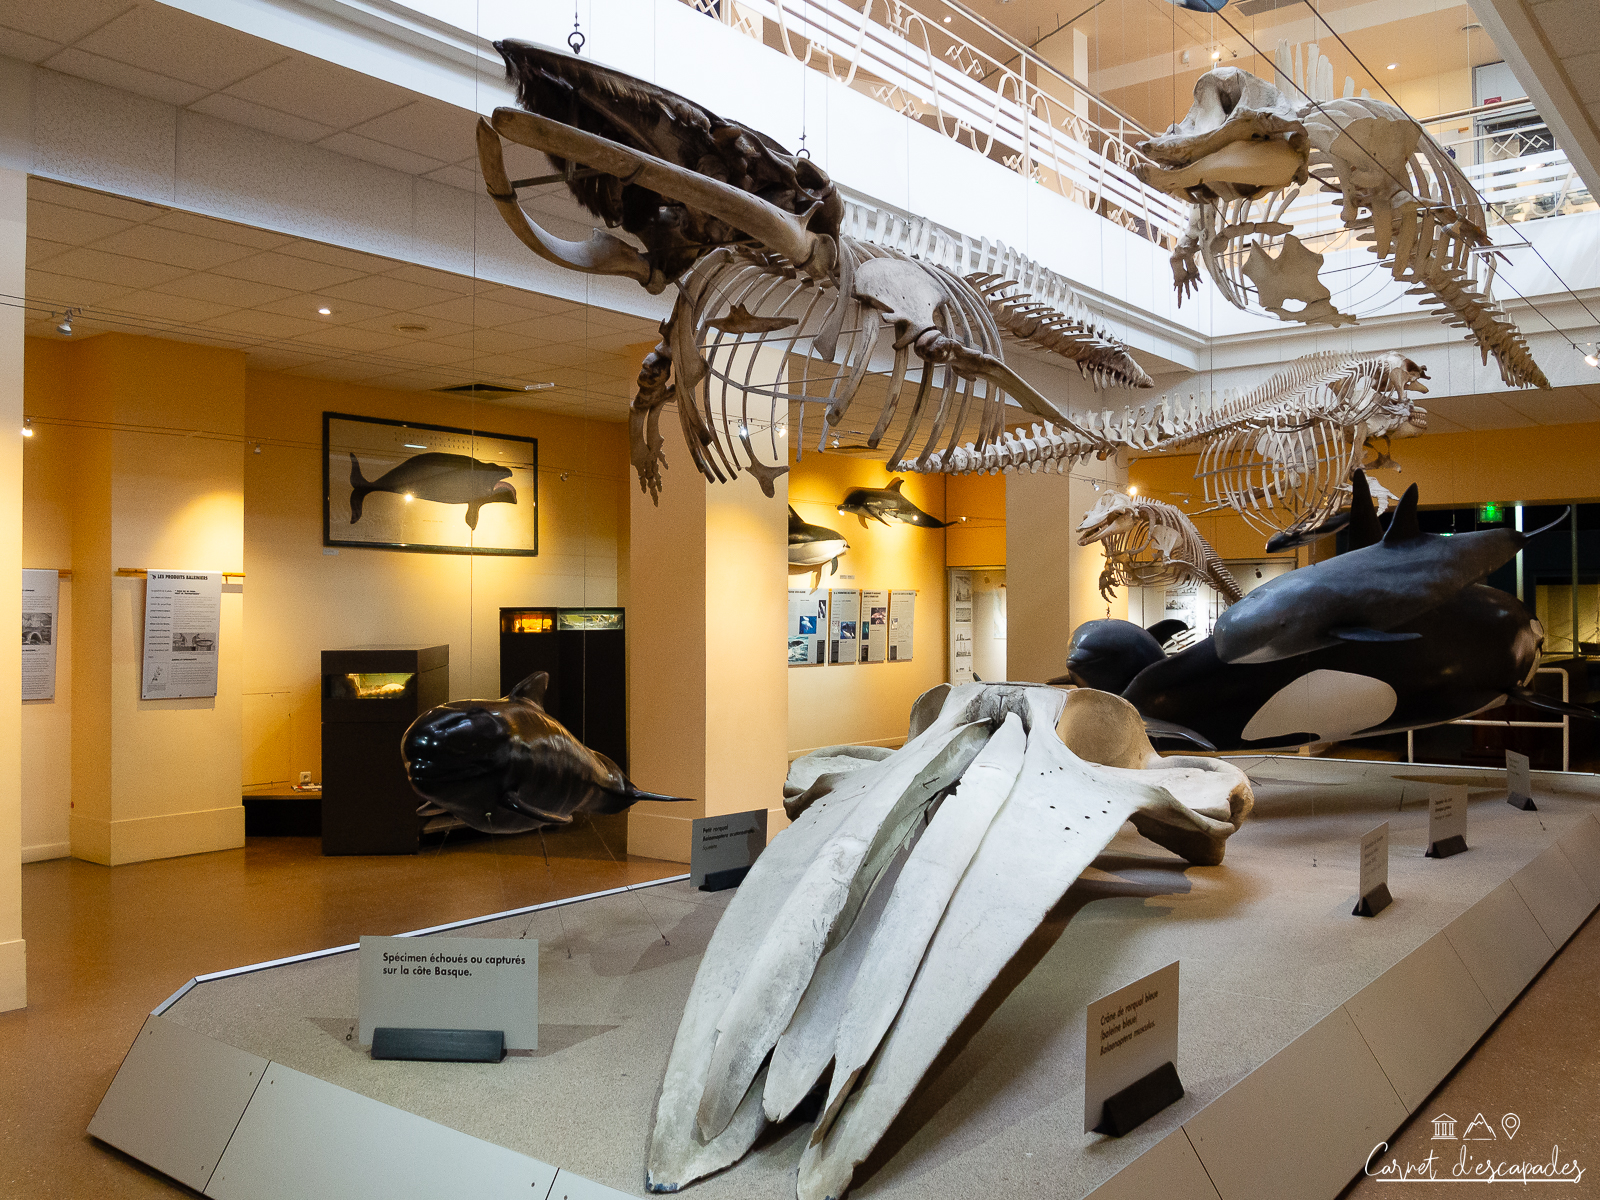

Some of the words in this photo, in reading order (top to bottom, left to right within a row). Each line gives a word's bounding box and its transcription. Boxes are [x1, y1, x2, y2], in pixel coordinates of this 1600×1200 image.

[382, 952, 427, 964] Spécimen
[429, 952, 468, 963] échoués
[485, 954, 526, 966] capturés
[382, 966, 398, 974] sur
[400, 965, 409, 975] la
[412, 965, 432, 976] côte
[434, 966, 472, 978] Basque.
[1117, 1005, 1124, 1017] de
[1125, 993, 1143, 1013] rorqual
[1145, 990, 1158, 1003] bleue
